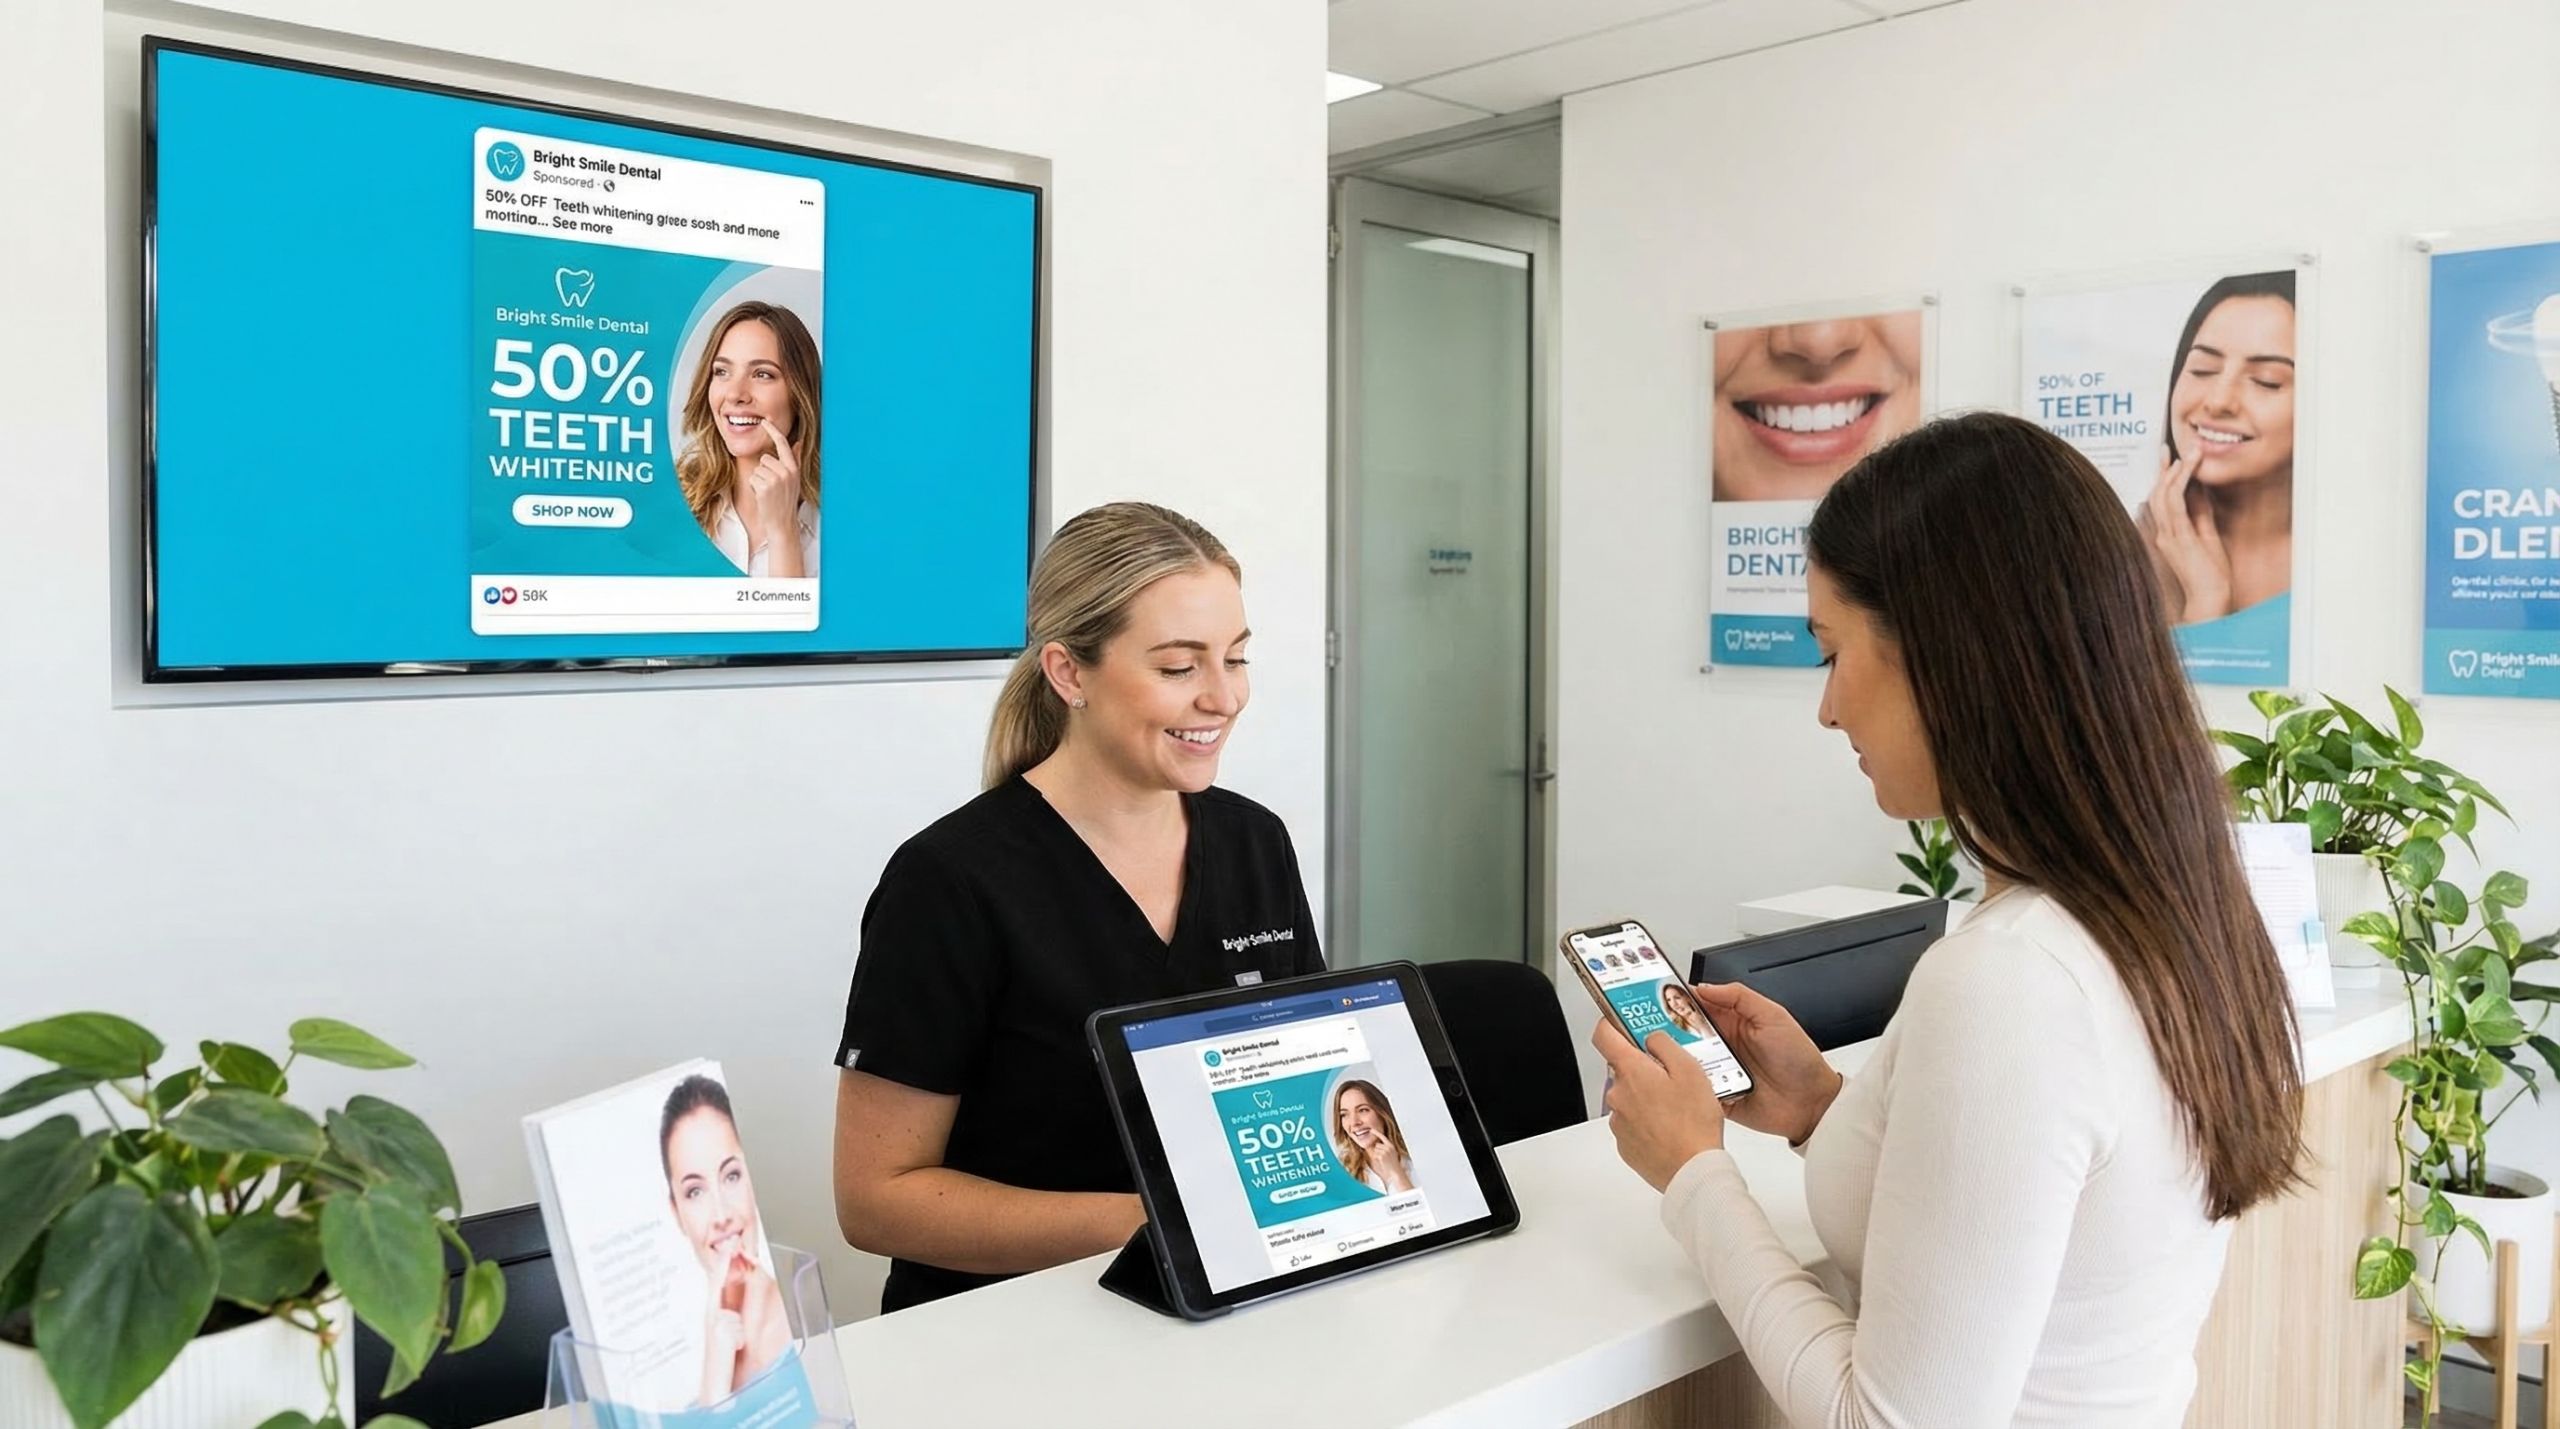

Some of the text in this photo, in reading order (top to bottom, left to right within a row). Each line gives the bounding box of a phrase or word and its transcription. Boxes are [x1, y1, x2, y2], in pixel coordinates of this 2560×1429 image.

[533, 149, 662, 181] Bright Smile Dental
[533, 170, 594, 189] Sponsored
[485, 188, 517, 205] 50%
[520, 193, 548, 208] OFF
[553, 197, 590, 215] Teeth
[593, 204, 654, 226] whitening
[552, 215, 577, 230] See
[580, 222, 613, 235] more
[496, 307, 649, 335] Bright Smile Dental
[490, 338, 654, 407] 50%
[2038, 372, 2106, 390] 50% OF
[2038, 392, 2132, 419] TEETH
[488, 407, 653, 455] TEETH
[488, 454, 654, 484] WHITENING
[531, 504, 615, 519] SHOP NOW
[736, 590, 811, 602] 21 Comments
[1237, 1116, 1316, 1155] 50%
[1244, 1143, 1325, 1175] TEETH
[1251, 1162, 1330, 1188] WHITENING
